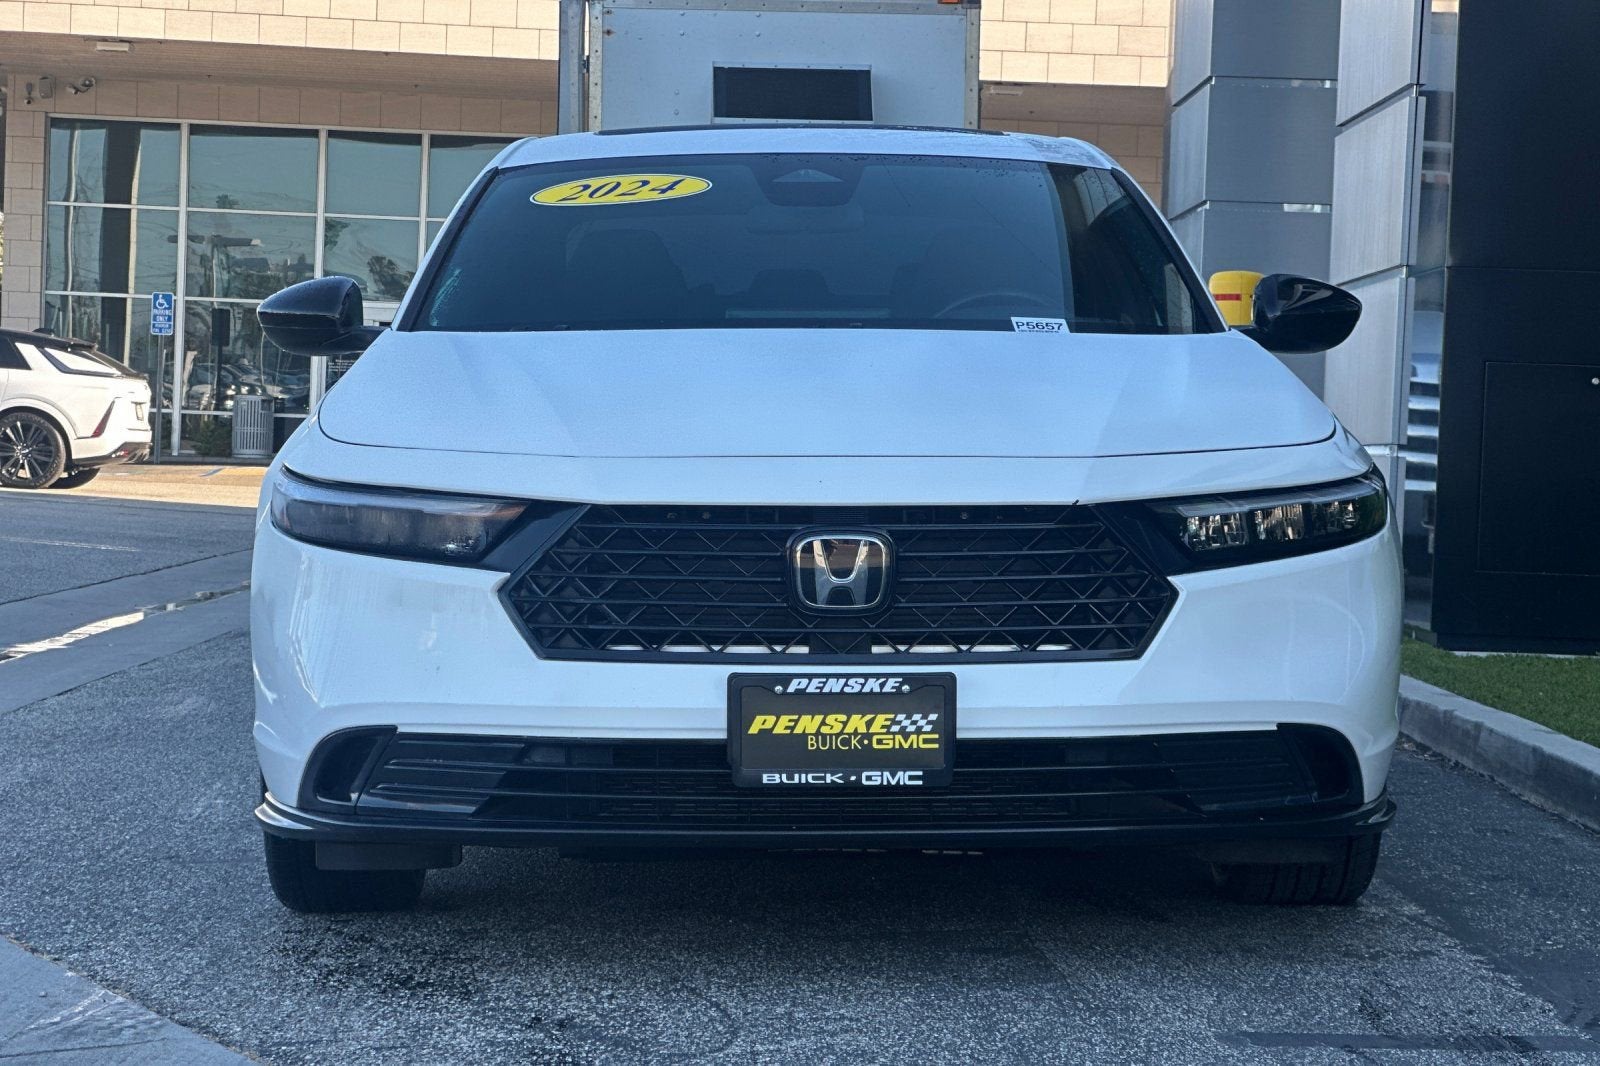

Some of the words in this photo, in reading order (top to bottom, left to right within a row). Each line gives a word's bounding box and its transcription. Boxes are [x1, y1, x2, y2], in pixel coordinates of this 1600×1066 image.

[555, 178, 686, 202] 2024
[1015, 321, 1063, 331] P5657
[786, 678, 903, 693] PENSKE
[747, 714, 895, 735] PENSKE
[762, 773, 845, 784] BUICK
[861, 771, 924, 785] GMC
